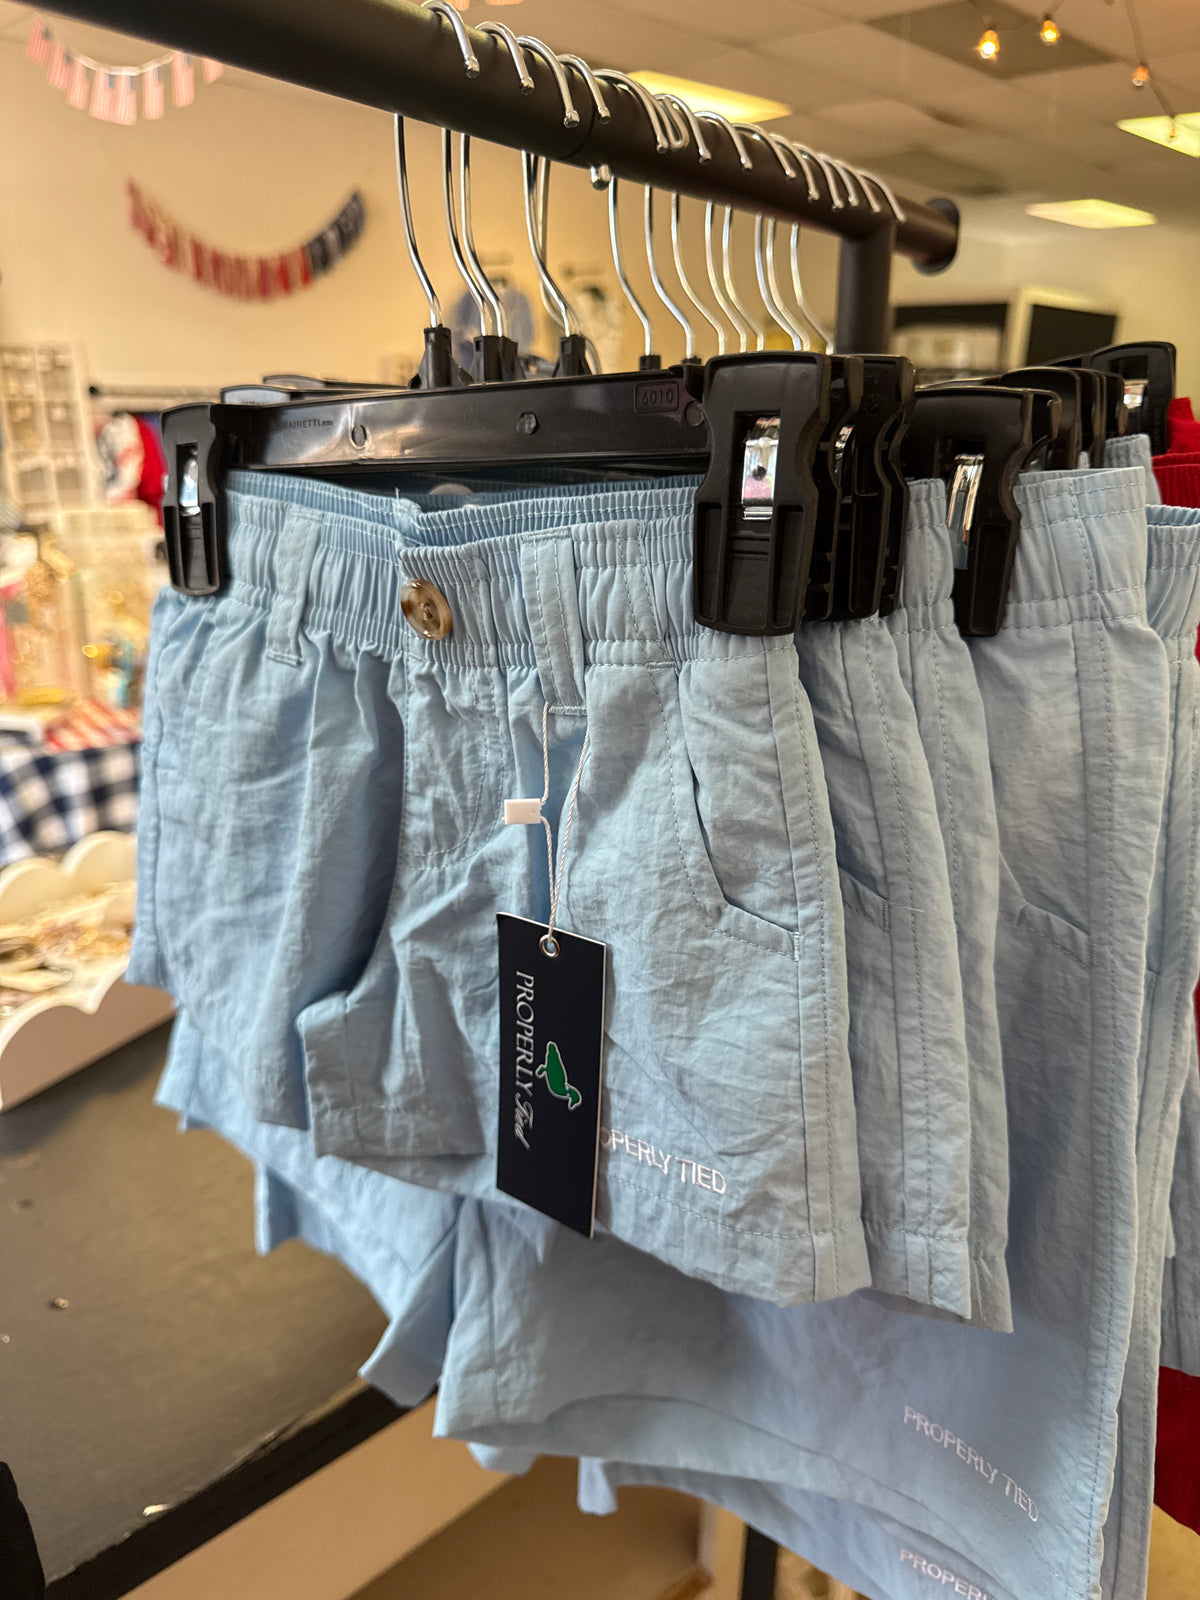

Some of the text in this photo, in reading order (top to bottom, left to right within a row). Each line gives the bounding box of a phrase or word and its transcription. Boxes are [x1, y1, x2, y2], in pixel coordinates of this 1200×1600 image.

[514, 970, 535, 1150] PROPERLY Tied
[600, 1126, 727, 1195] OPERLY TIED
[903, 1405, 1039, 1522] PROPERLY TIED
